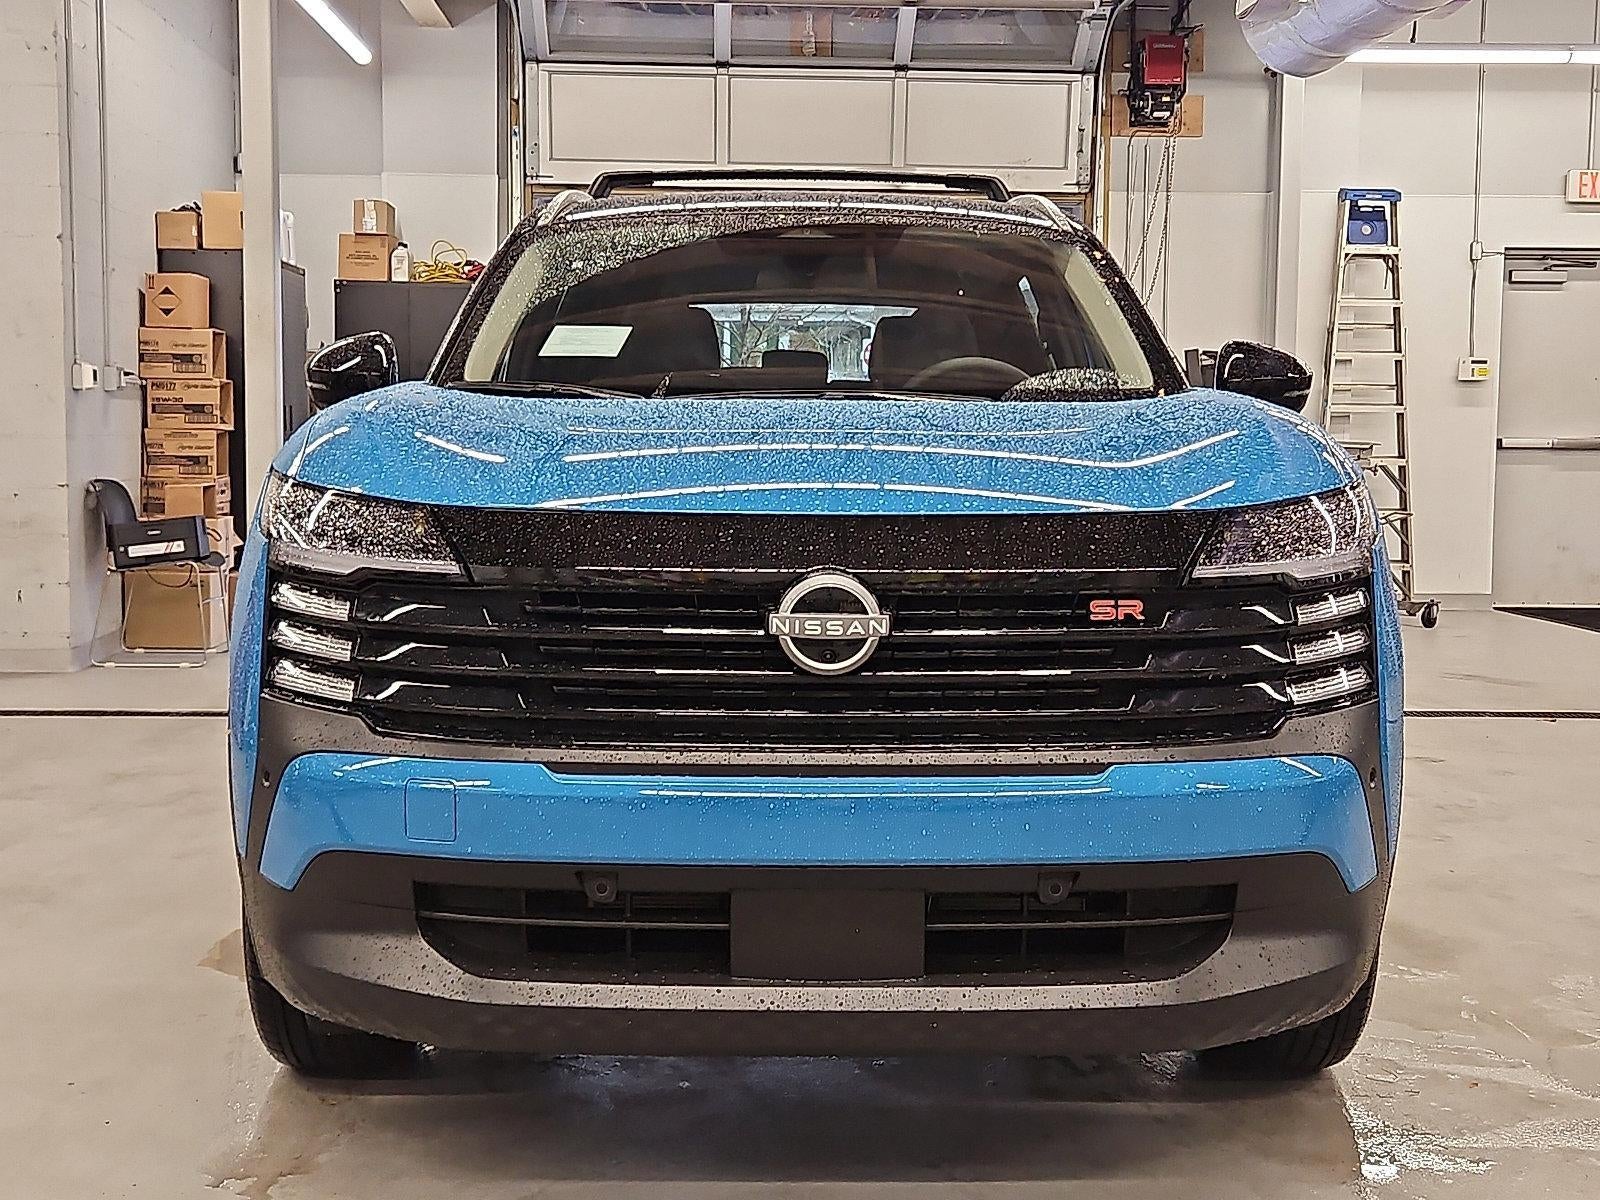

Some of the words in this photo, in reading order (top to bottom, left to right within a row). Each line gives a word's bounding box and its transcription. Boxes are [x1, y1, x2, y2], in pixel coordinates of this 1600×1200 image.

[1579, 171, 1600, 198] EX
[1090, 600, 1145, 620] SR
[771, 617, 887, 636] NISSAN
